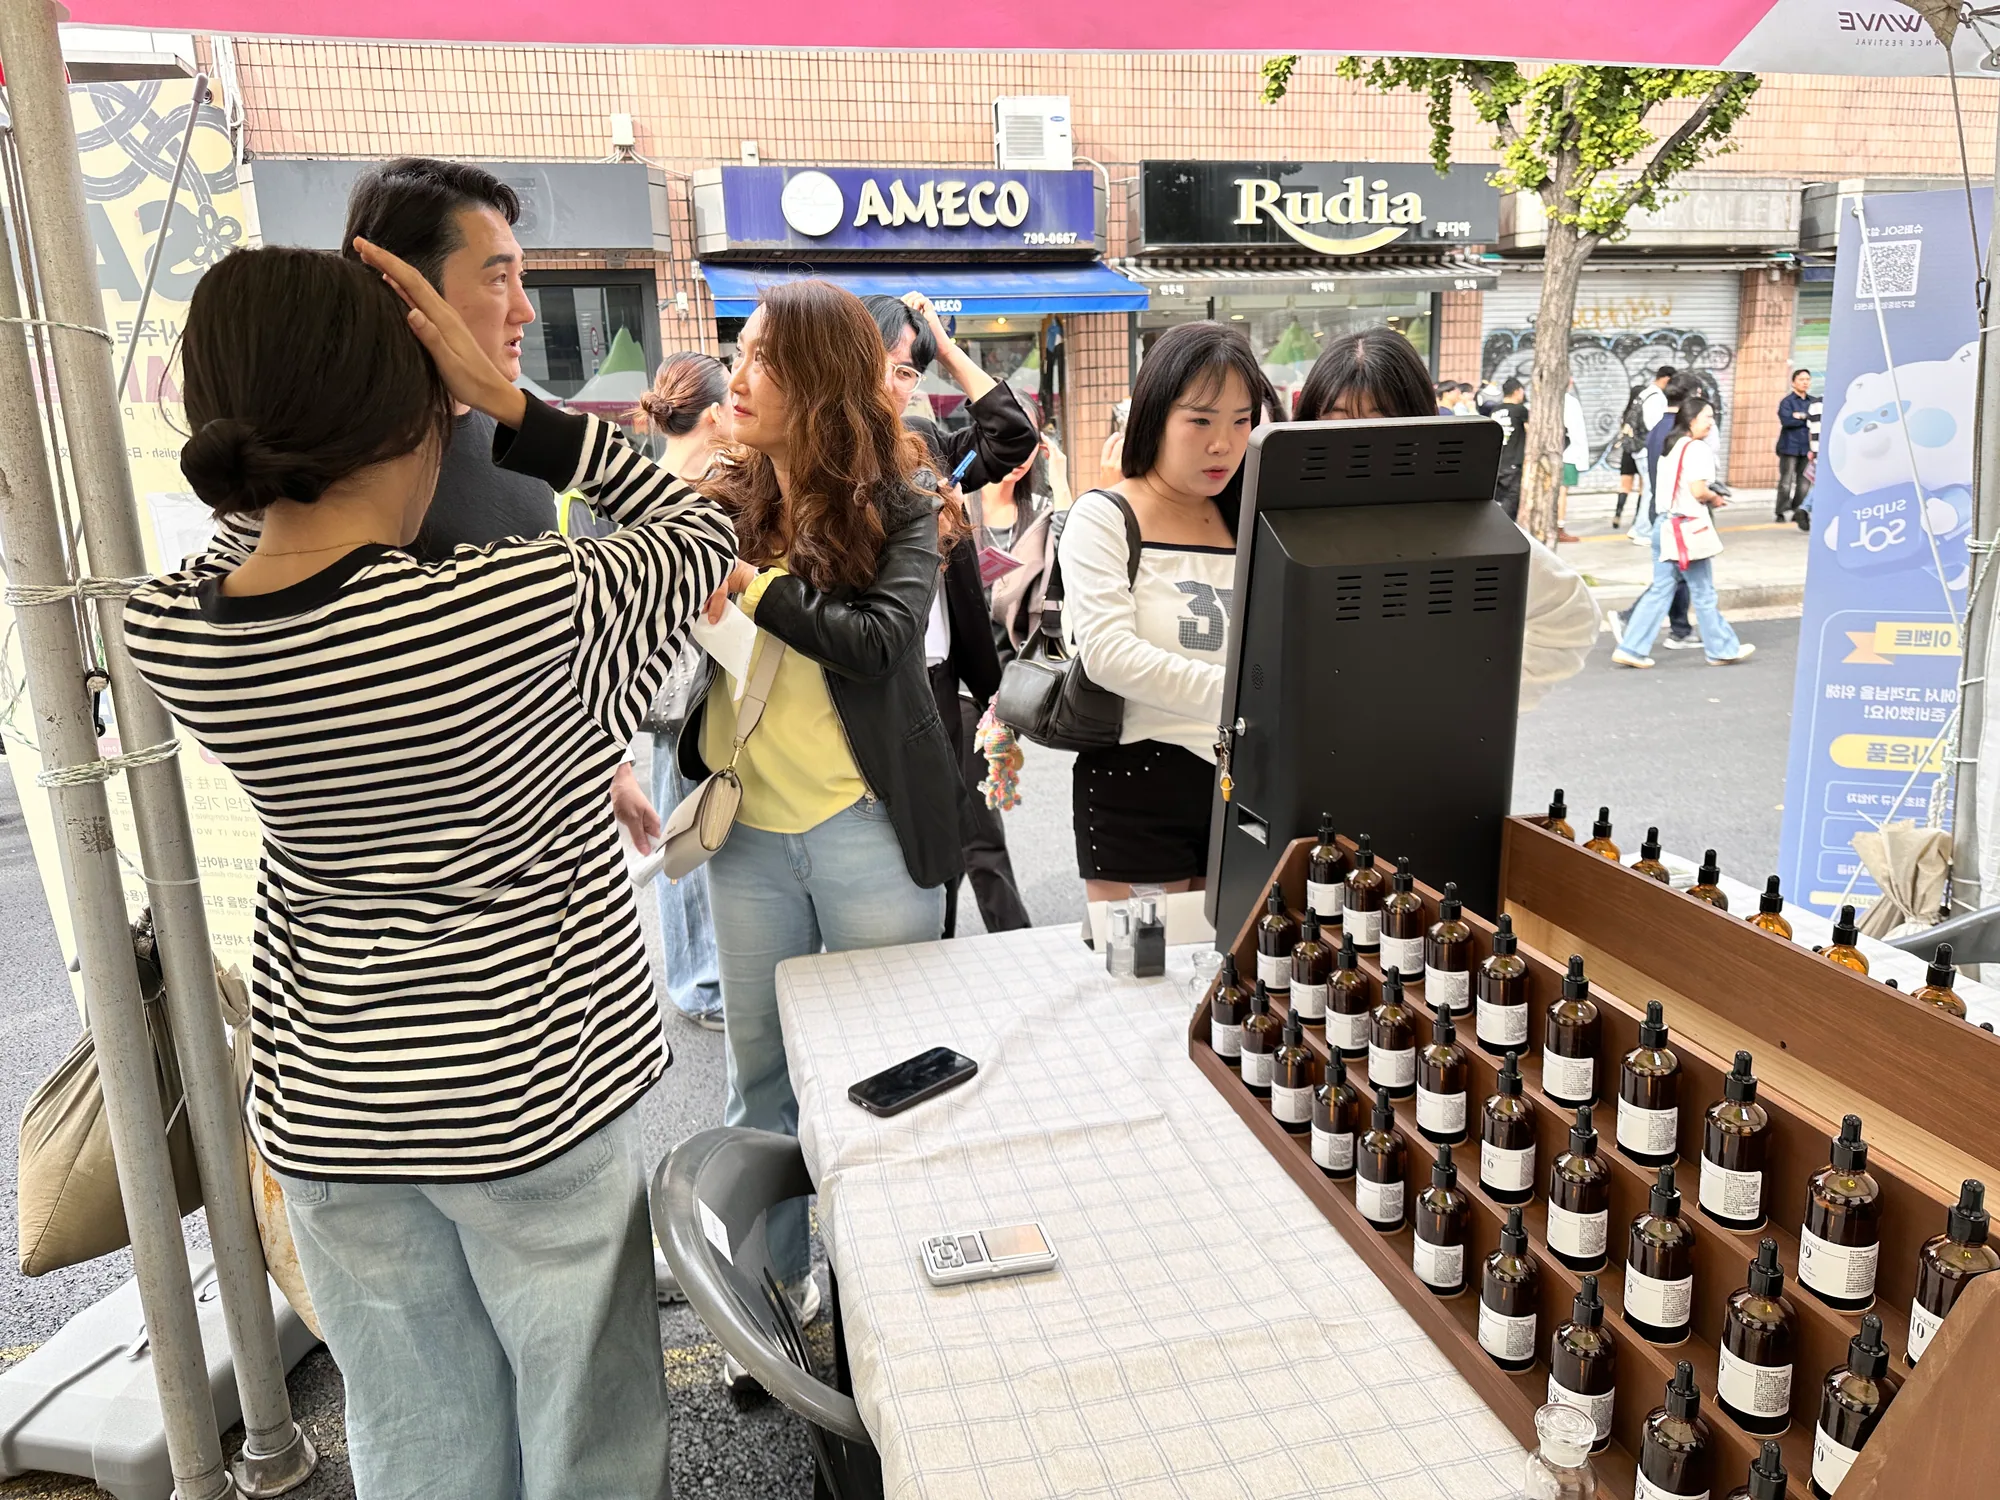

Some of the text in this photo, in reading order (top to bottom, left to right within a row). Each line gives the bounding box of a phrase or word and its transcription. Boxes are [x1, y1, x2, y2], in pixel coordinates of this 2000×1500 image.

[853, 179, 1029, 228] AMECO
[1234, 176, 1426, 254] Rudia
[1435, 221, 1472, 237] 루디아
[930, 299, 962, 312] MECO
[1911, 1315, 1925, 1339] 10
